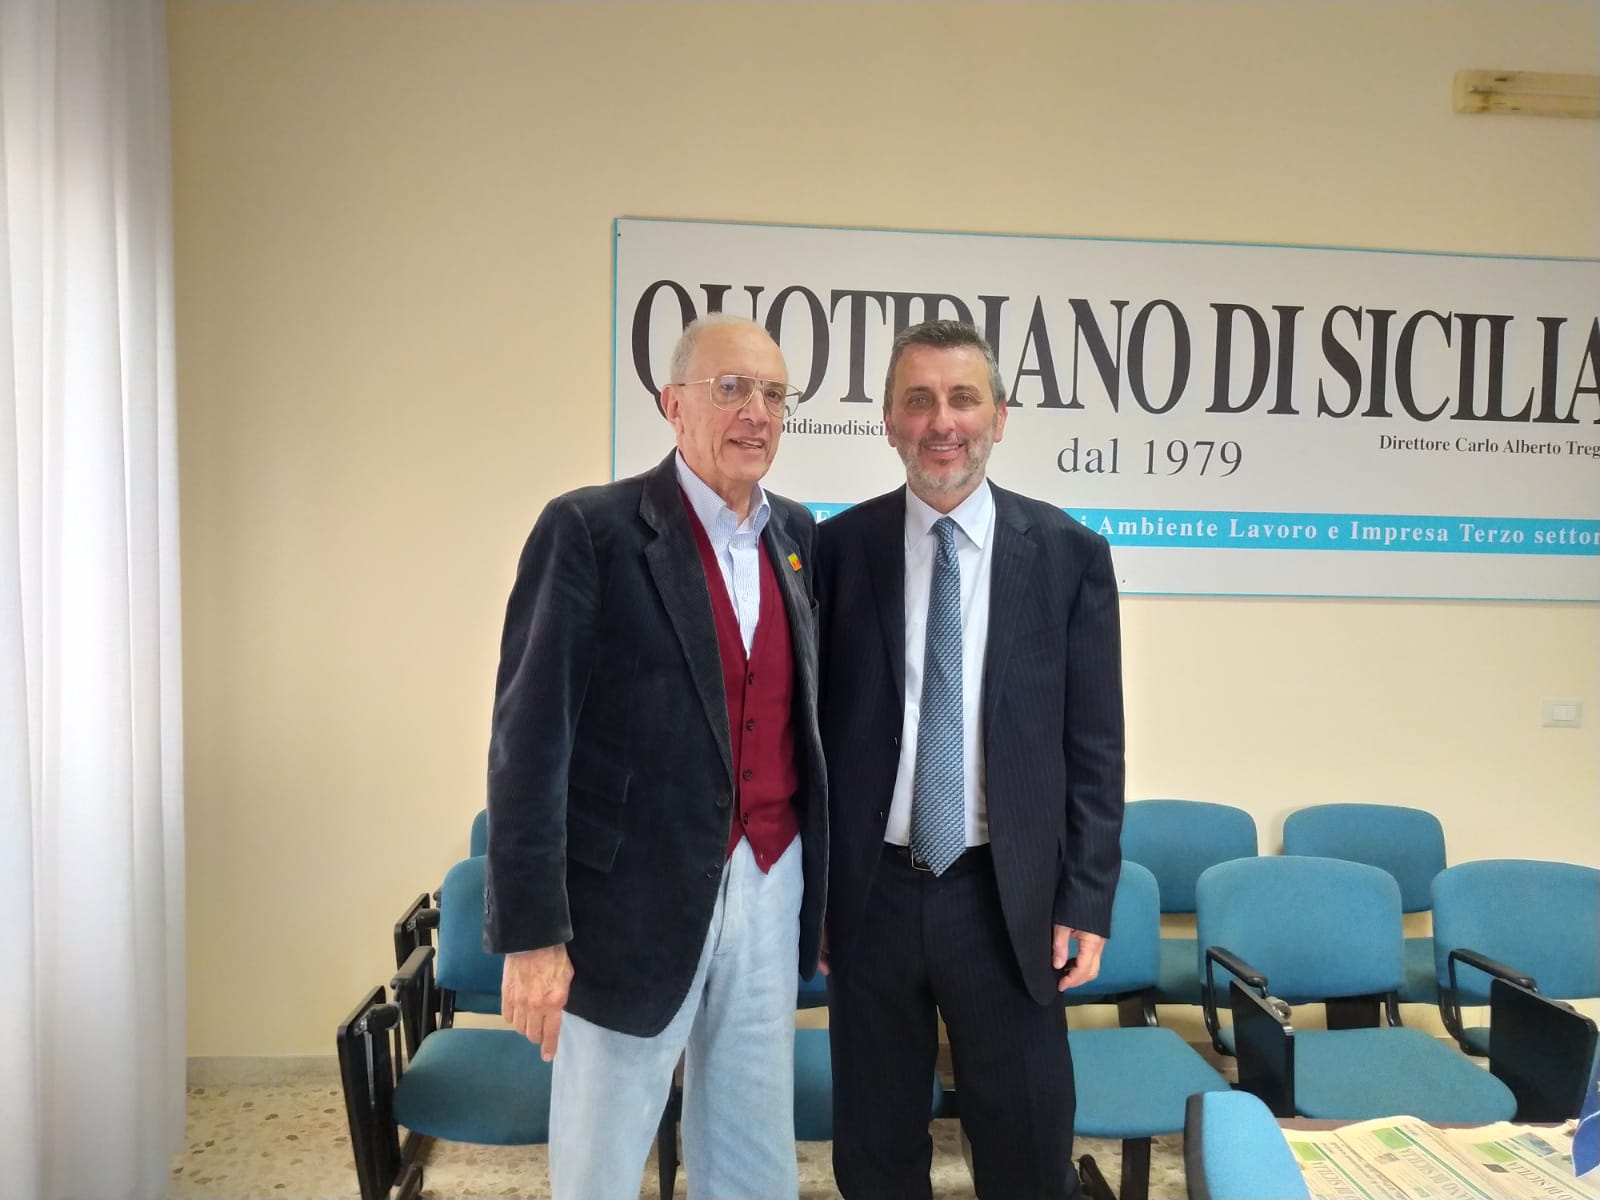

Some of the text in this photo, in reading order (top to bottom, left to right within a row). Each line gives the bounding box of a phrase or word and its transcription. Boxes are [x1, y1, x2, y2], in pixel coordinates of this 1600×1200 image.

[1205, 303, 1304, 415] DI
[1057, 437, 1242, 477] dal 1979
[1379, 435, 1450, 450] Direttore
[1455, 437, 1499, 453] Carlo
[1503, 439, 1561, 454] Alberto
[1099, 516, 1218, 537] Ambiente
[1229, 518, 1317, 539] Lavoro
[1328, 525, 1339, 539] e
[1350, 521, 1448, 545] Impresa
[1459, 523, 1524, 543] Terzo
